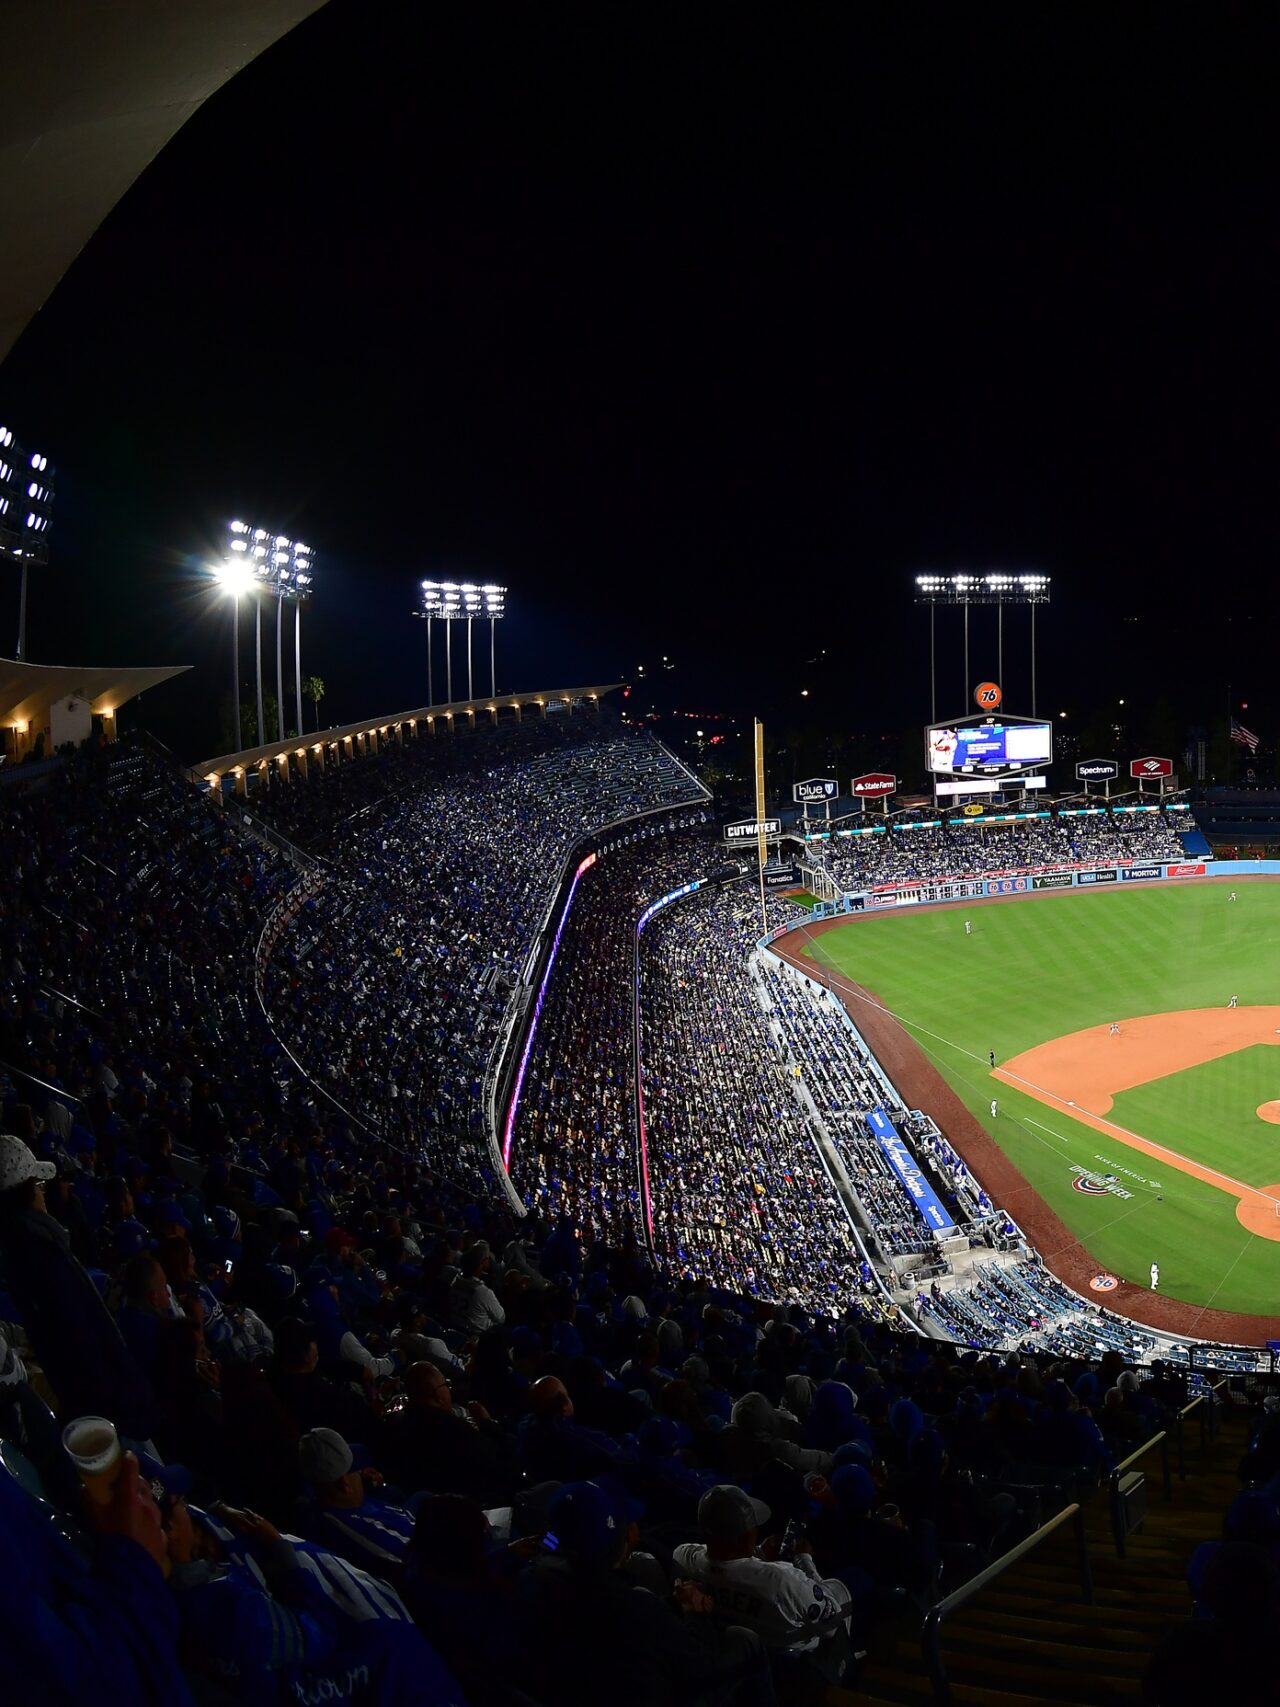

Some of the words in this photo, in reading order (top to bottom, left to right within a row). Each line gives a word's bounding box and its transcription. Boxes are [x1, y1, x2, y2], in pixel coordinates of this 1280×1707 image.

[981, 689, 997, 702] 76
[1080, 767, 1112, 776] Spectrum
[799, 785, 823, 796] blue
[728, 822, 777, 837] CUTWATER
[768, 876, 793, 884] Fanatics
[1094, 1154, 1110, 1165] BANK
[1119, 1166, 1148, 1183] AMERICA
[1068, 1165, 1109, 1186] OPENING
[1106, 1183, 1135, 1200] WEEK
[1095, 1279, 1114, 1288] 76
